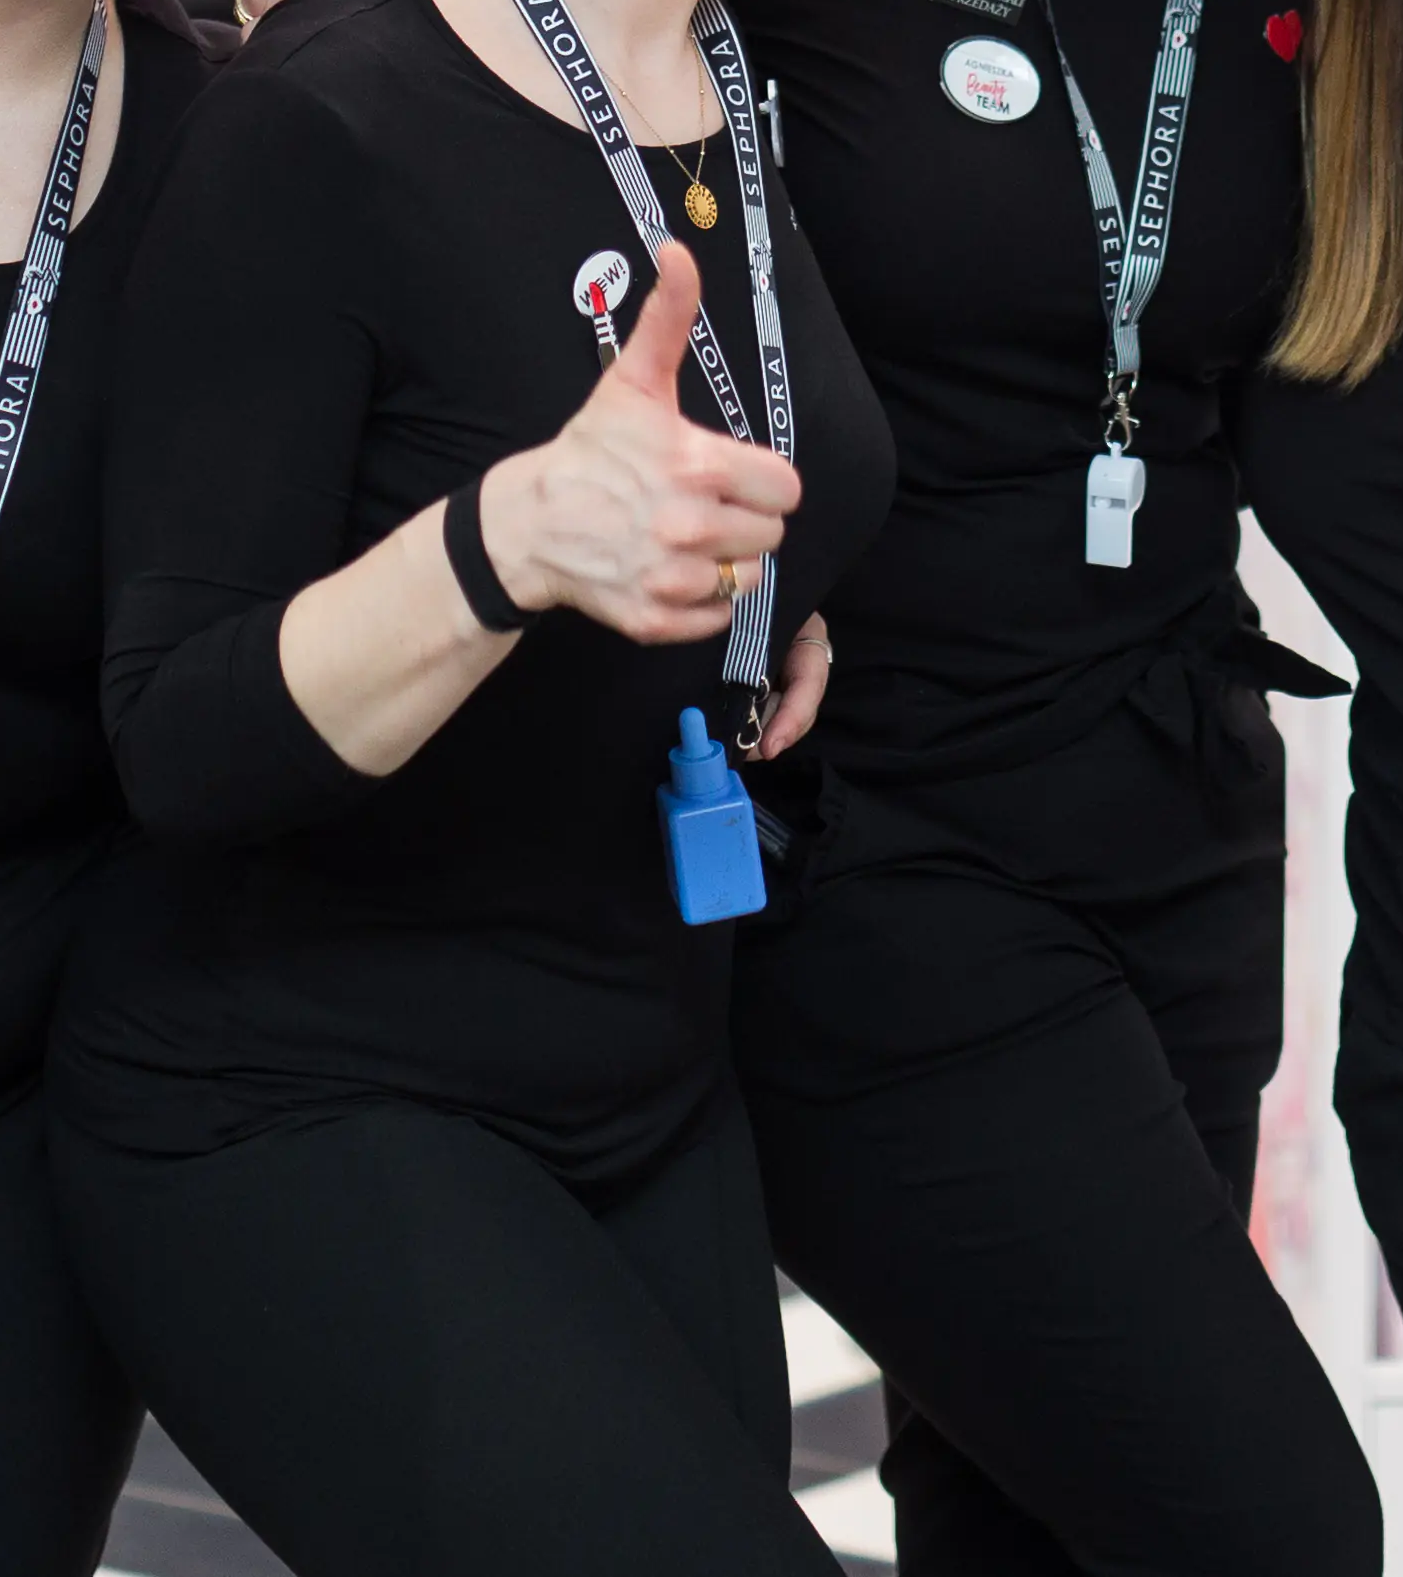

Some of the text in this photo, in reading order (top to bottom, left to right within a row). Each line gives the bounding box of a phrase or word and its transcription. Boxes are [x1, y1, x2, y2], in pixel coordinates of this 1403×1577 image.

[48, 81, 95, 231] SEPHORA
[711, 39, 760, 197] SEPHORA
[976, 94, 1011, 114] TEAM
[1137, 104, 1181, 248] SEPHORA
[1100, 217, 1122, 301] SEPH
[692, 320, 748, 439] EPHOR
[768, 358, 790, 456] HORA
